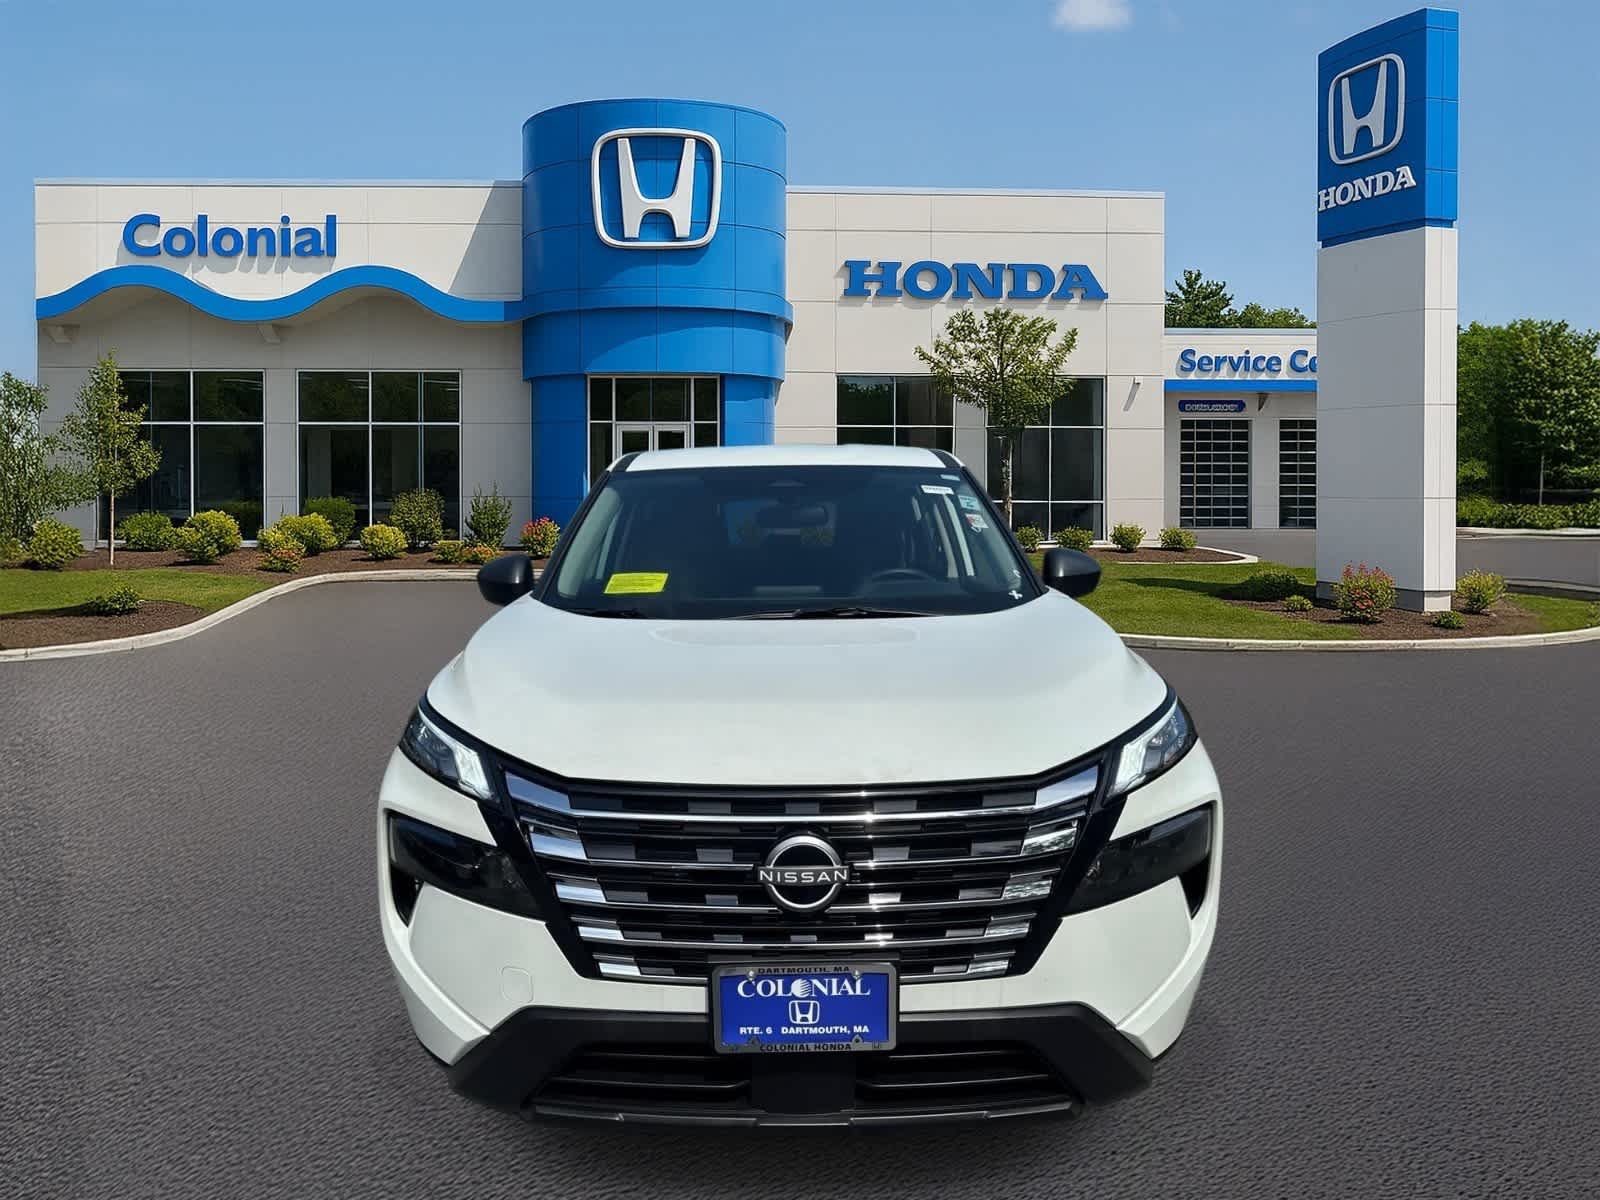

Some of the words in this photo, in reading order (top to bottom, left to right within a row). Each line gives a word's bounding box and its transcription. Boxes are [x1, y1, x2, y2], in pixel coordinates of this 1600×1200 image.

[1318, 165, 1417, 212] HONDA
[122, 213, 337, 257] Colonial
[844, 260, 1109, 300] HONDA
[1180, 348, 1282, 373] Service
[760, 869, 848, 883] NISSAN
[737, 978, 871, 997] COLONIAL
[739, 1026, 763, 1035] RTE.
[766, 1026, 773, 1034] 6
[781, 1025, 850, 1036] DARTMOUTH,
[853, 1025, 870, 1034] MA
[760, 1043, 810, 1052] COLONIAL
[814, 1042, 852, 1051] HONDA
